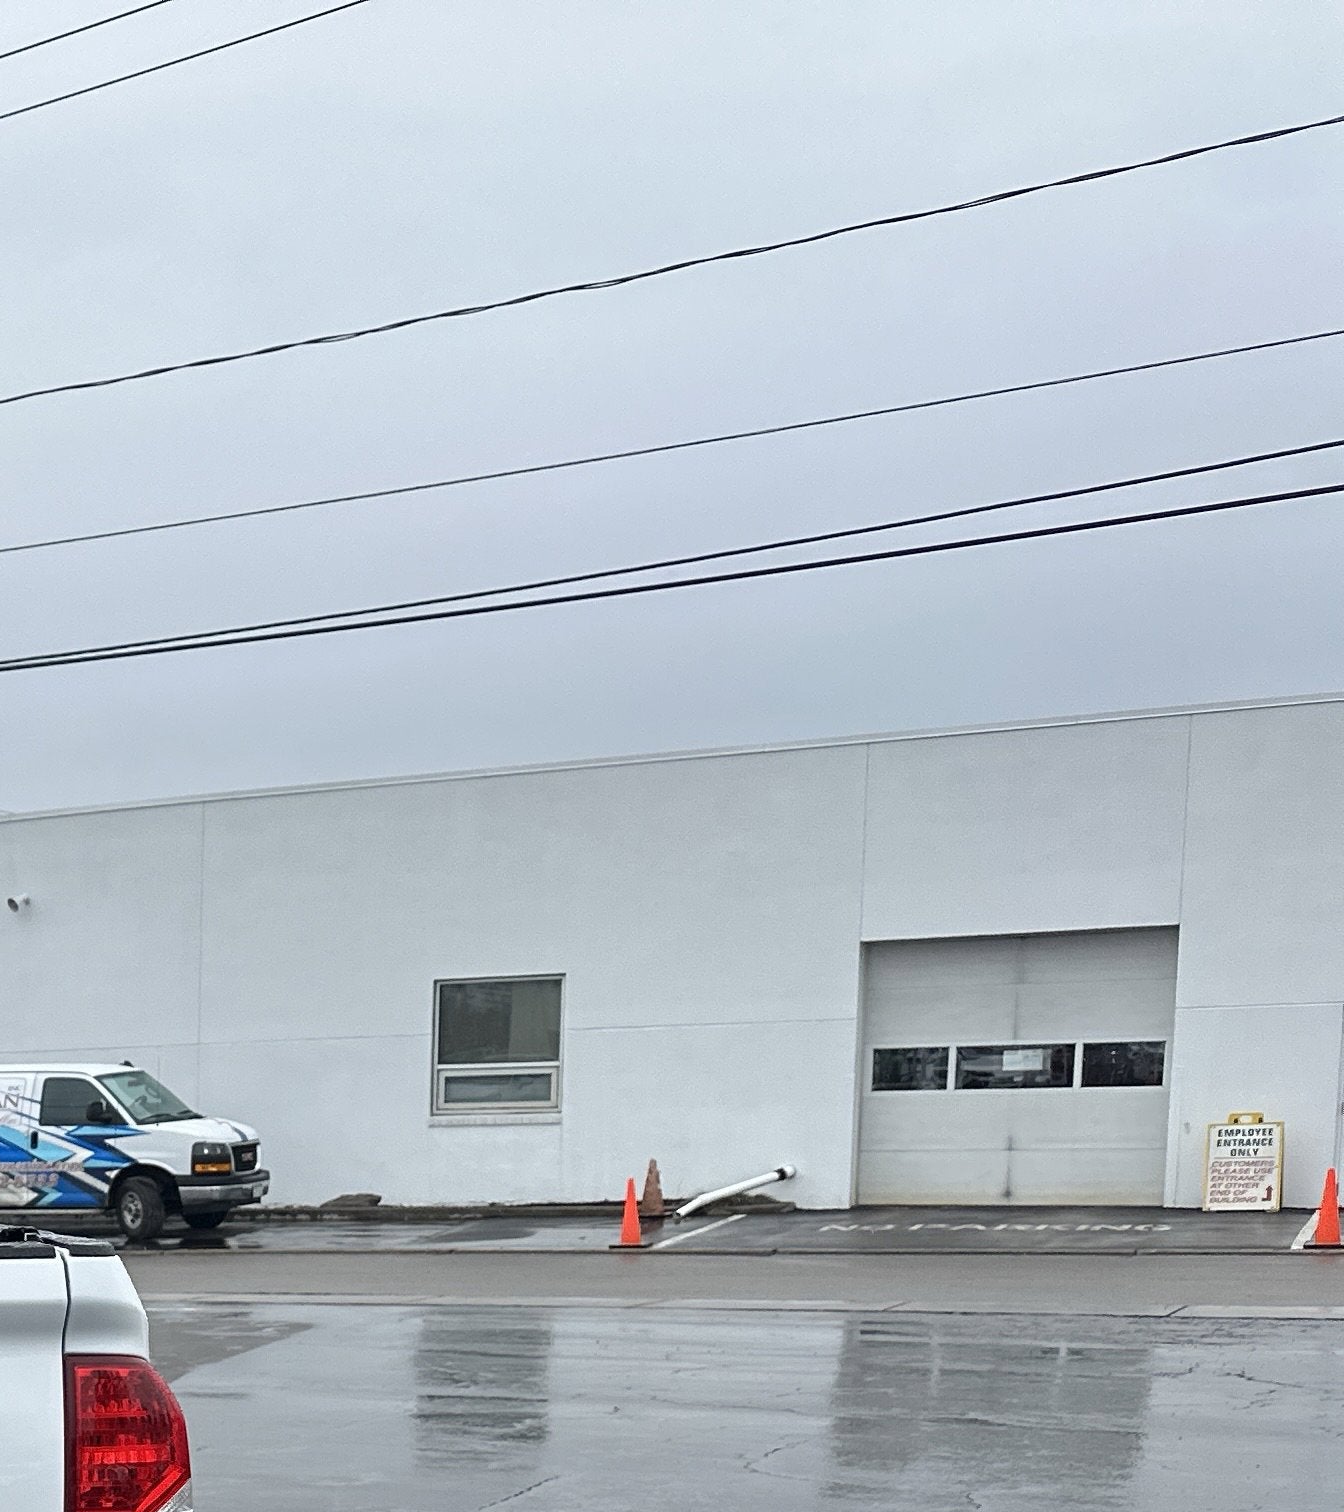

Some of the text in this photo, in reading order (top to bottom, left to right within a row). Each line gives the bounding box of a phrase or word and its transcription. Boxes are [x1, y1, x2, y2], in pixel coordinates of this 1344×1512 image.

[1217, 1128, 1274, 1137] EMPLOYEE
[1216, 1138, 1274, 1147] ENTRANCE
[1230, 1148, 1259, 1156] ONLY
[1211, 1167, 1274, 1175] PLEASE USE
[1209, 1196, 1258, 1204] BUILDING
[819, 1223, 1173, 1232] NO PARKING
